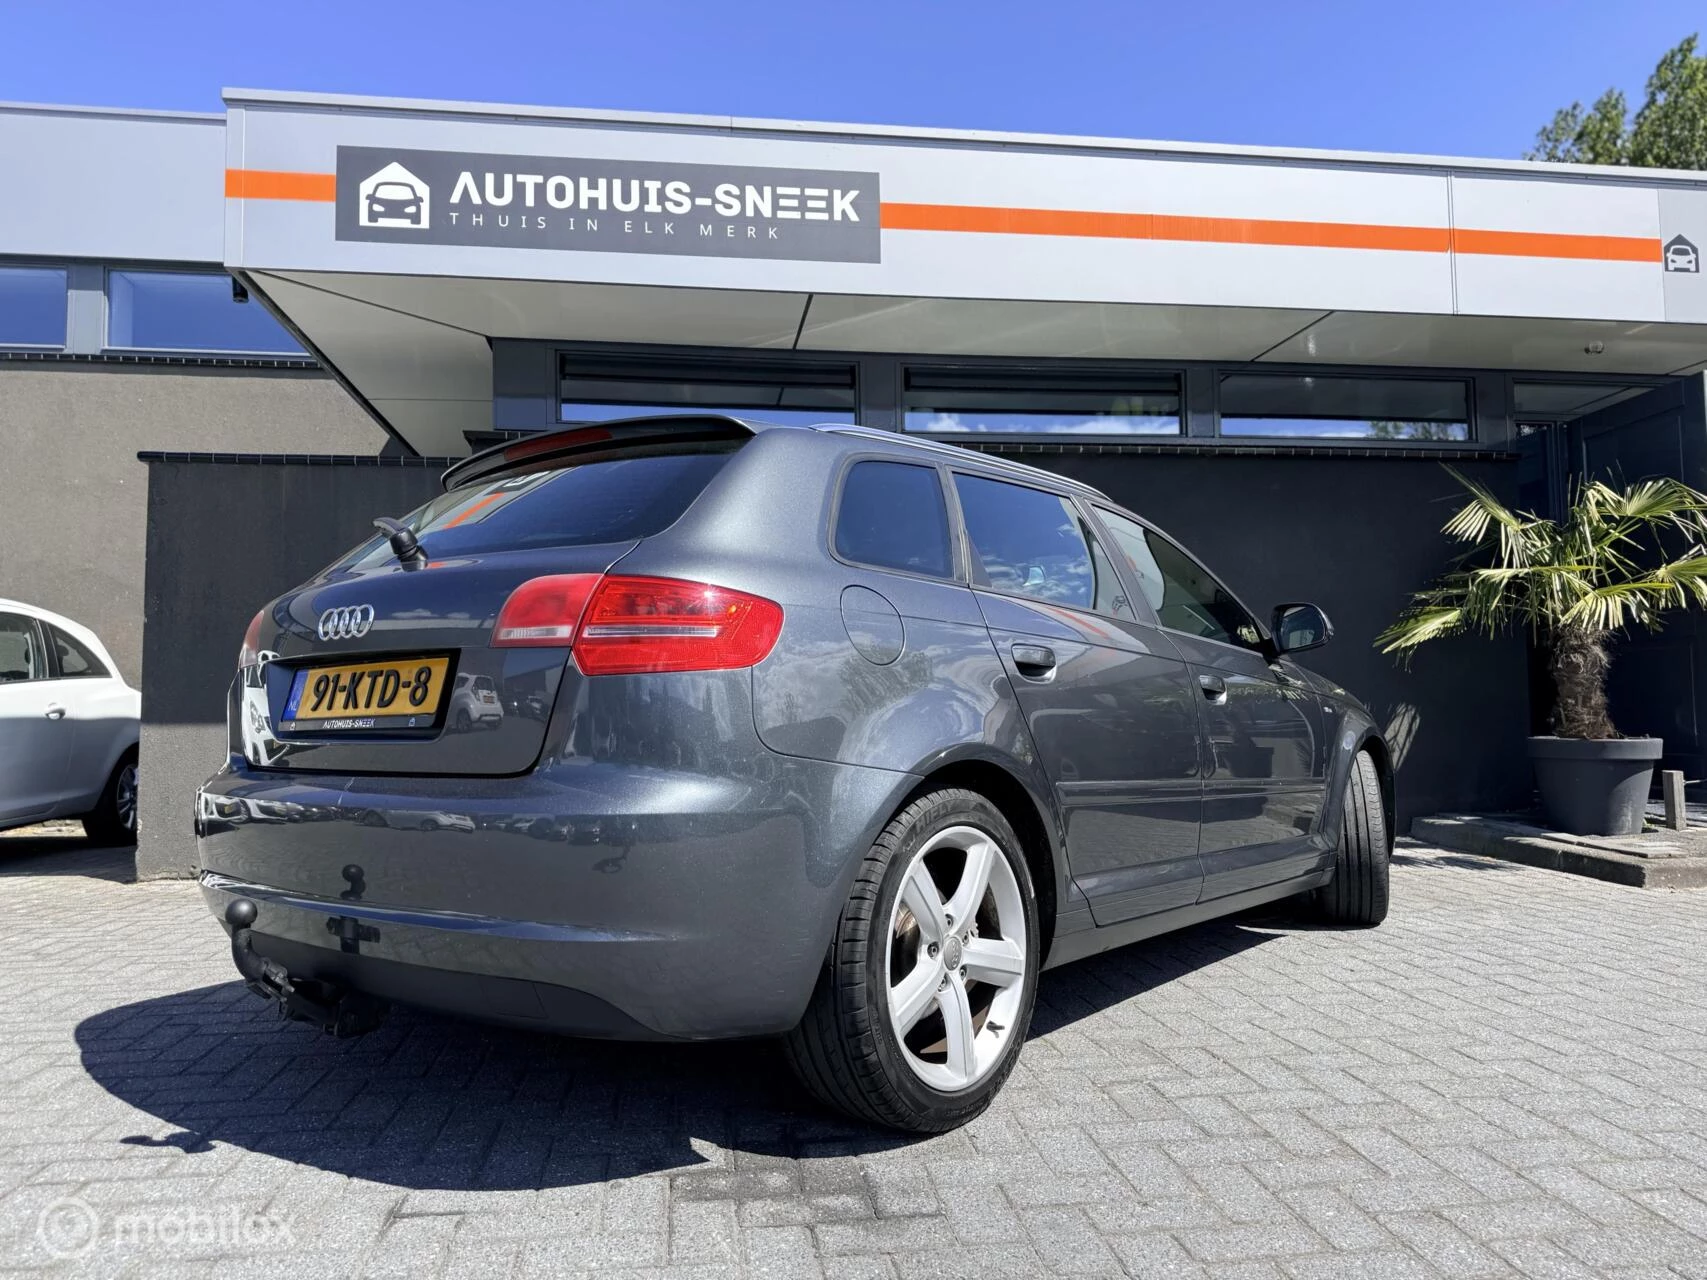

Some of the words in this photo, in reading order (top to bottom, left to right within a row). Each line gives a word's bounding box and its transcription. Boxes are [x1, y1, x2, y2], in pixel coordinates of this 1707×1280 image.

[449, 171, 860, 222] AUTOHUIS-SNEEK
[449, 212, 546, 229] THUIS
[569, 218, 598, 231] IN
[624, 221, 675, 235] ELK
[700, 223, 780, 239] MERK
[311, 667, 432, 711] 91-KTD-8
[288, 701, 298, 711] NL
[323, 719, 376, 728] AUTOHUIS-SNEEK
